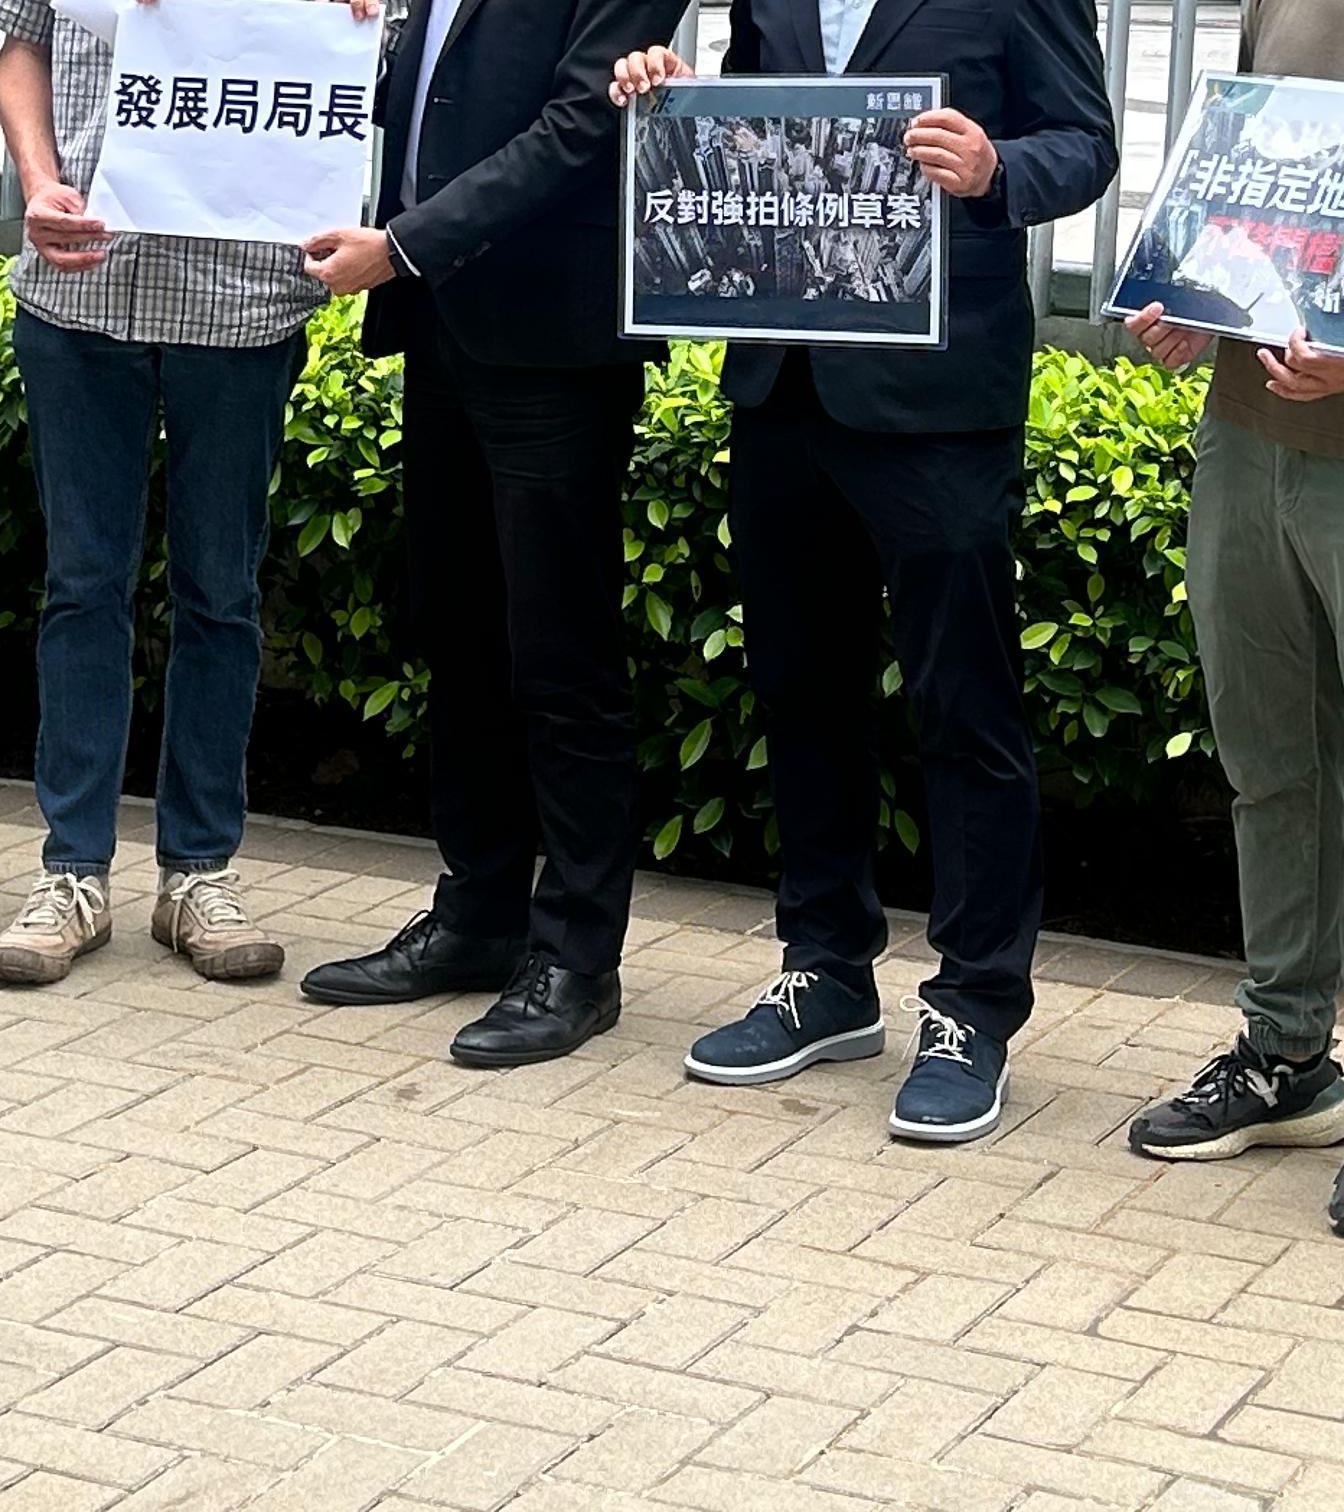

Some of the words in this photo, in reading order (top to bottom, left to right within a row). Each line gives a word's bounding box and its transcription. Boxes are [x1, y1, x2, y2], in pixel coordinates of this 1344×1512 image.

[115, 72, 369, 141] 發展局局長
[643, 189, 922, 230] 反對強拍條例草案
[1204, 215, 1344, 276] 門檻
